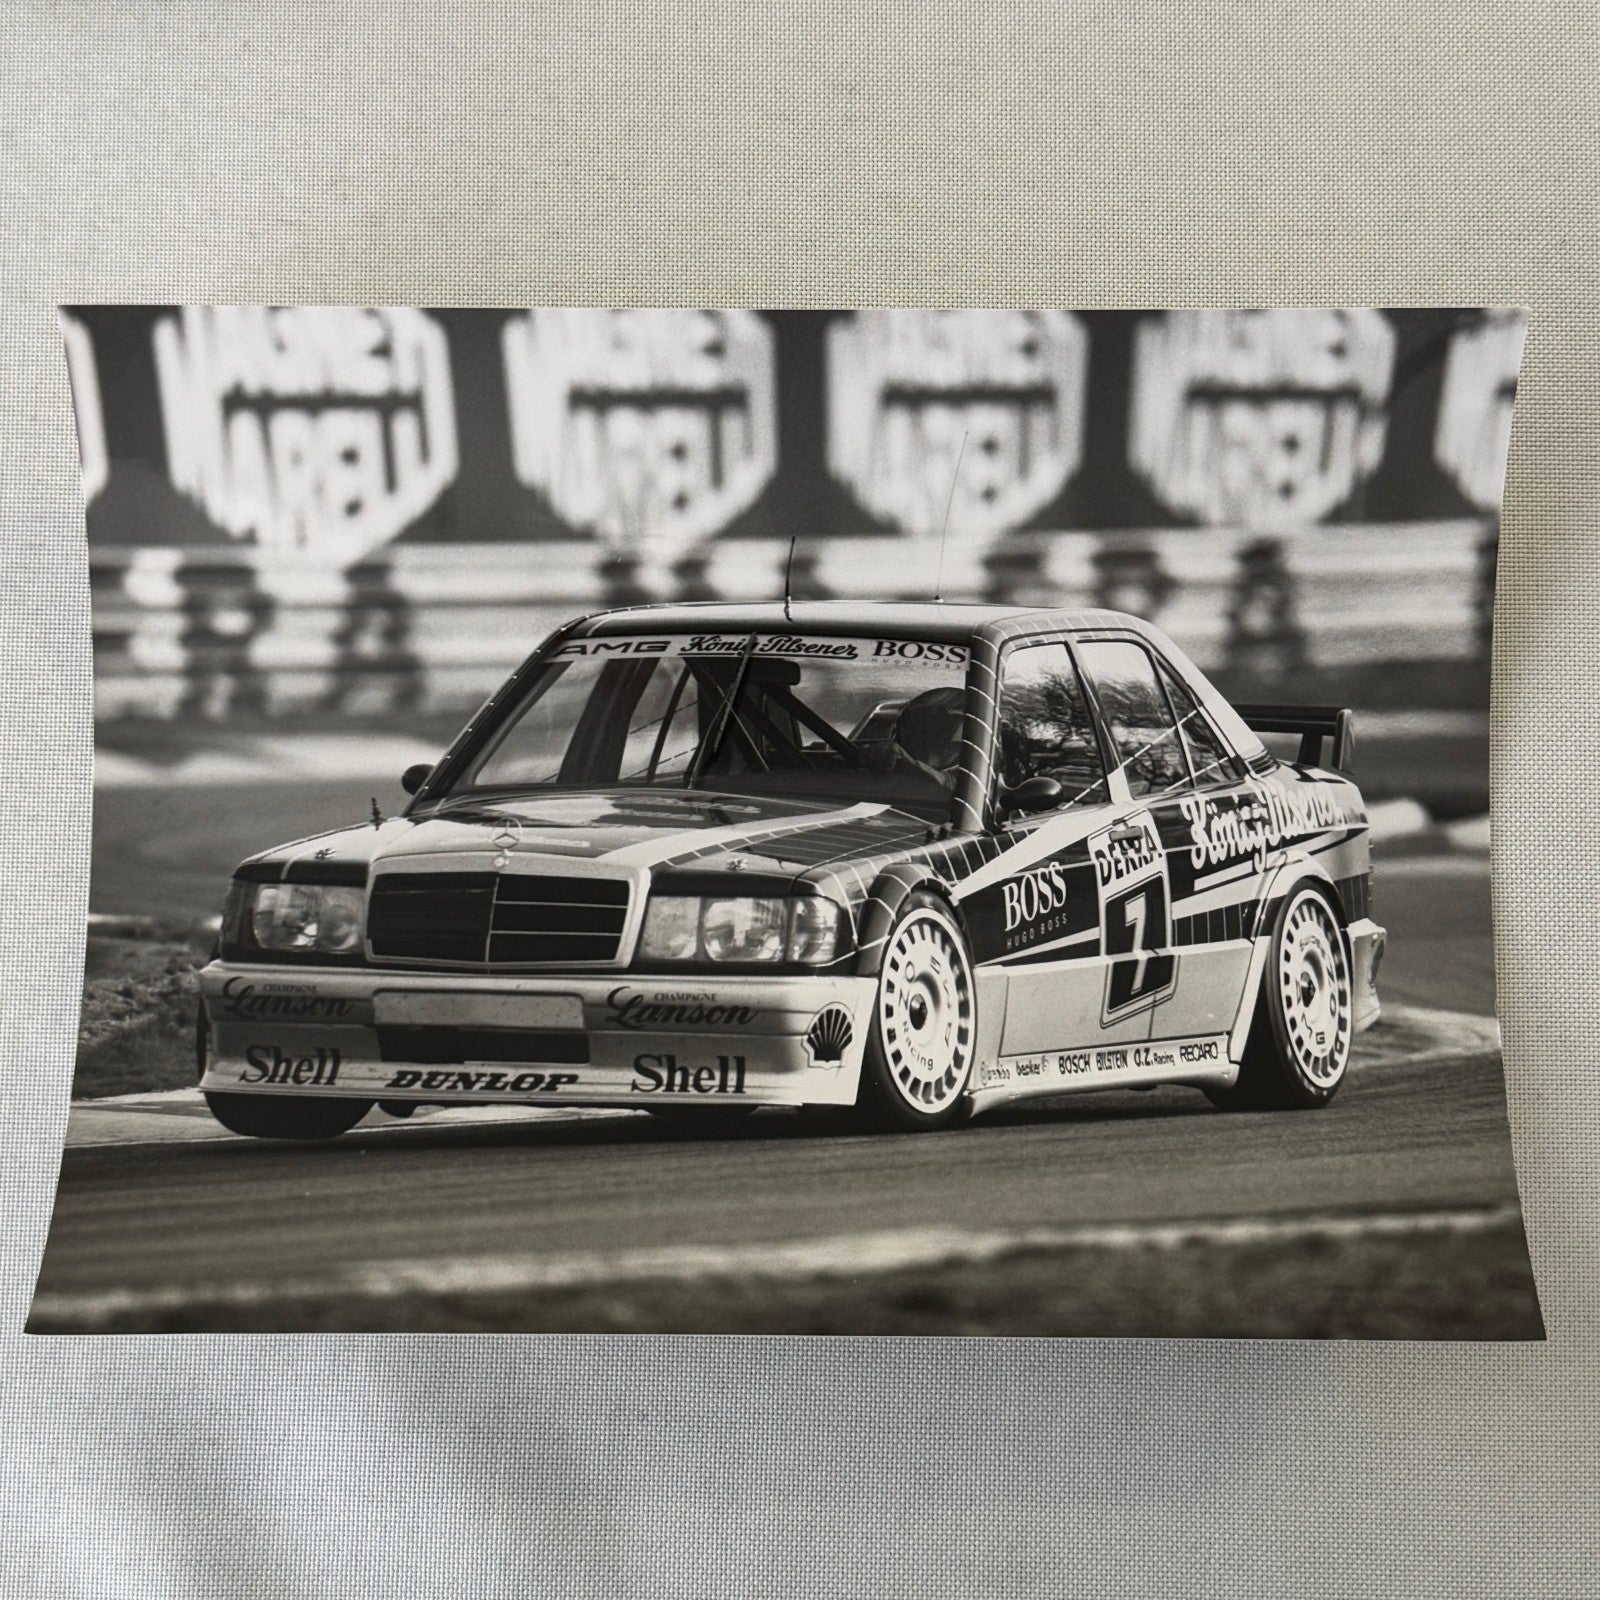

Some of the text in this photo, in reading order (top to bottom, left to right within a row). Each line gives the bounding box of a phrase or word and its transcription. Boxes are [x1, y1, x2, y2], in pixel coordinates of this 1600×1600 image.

[550, 640, 671, 658] AMG
[872, 640, 967, 663] BOSS
[1002, 861, 1067, 932] BOSS
[1006, 913, 1067, 950] HUGO BOSS
[605, 986, 758, 1029] Lanson
[654, 992, 717, 1001] CHAMPAGNE
[239, 1045, 341, 1085] Shell
[631, 1054, 746, 1094] Shell
[1059, 1053, 1091, 1074] BOSCH
[1096, 1050, 1128, 1071] BILSTEIN
[1153, 1051, 1175, 1066] Racing
[1179, 1042, 1218, 1061] RECARO
[385, 1071, 579, 1092] DUNLOP
